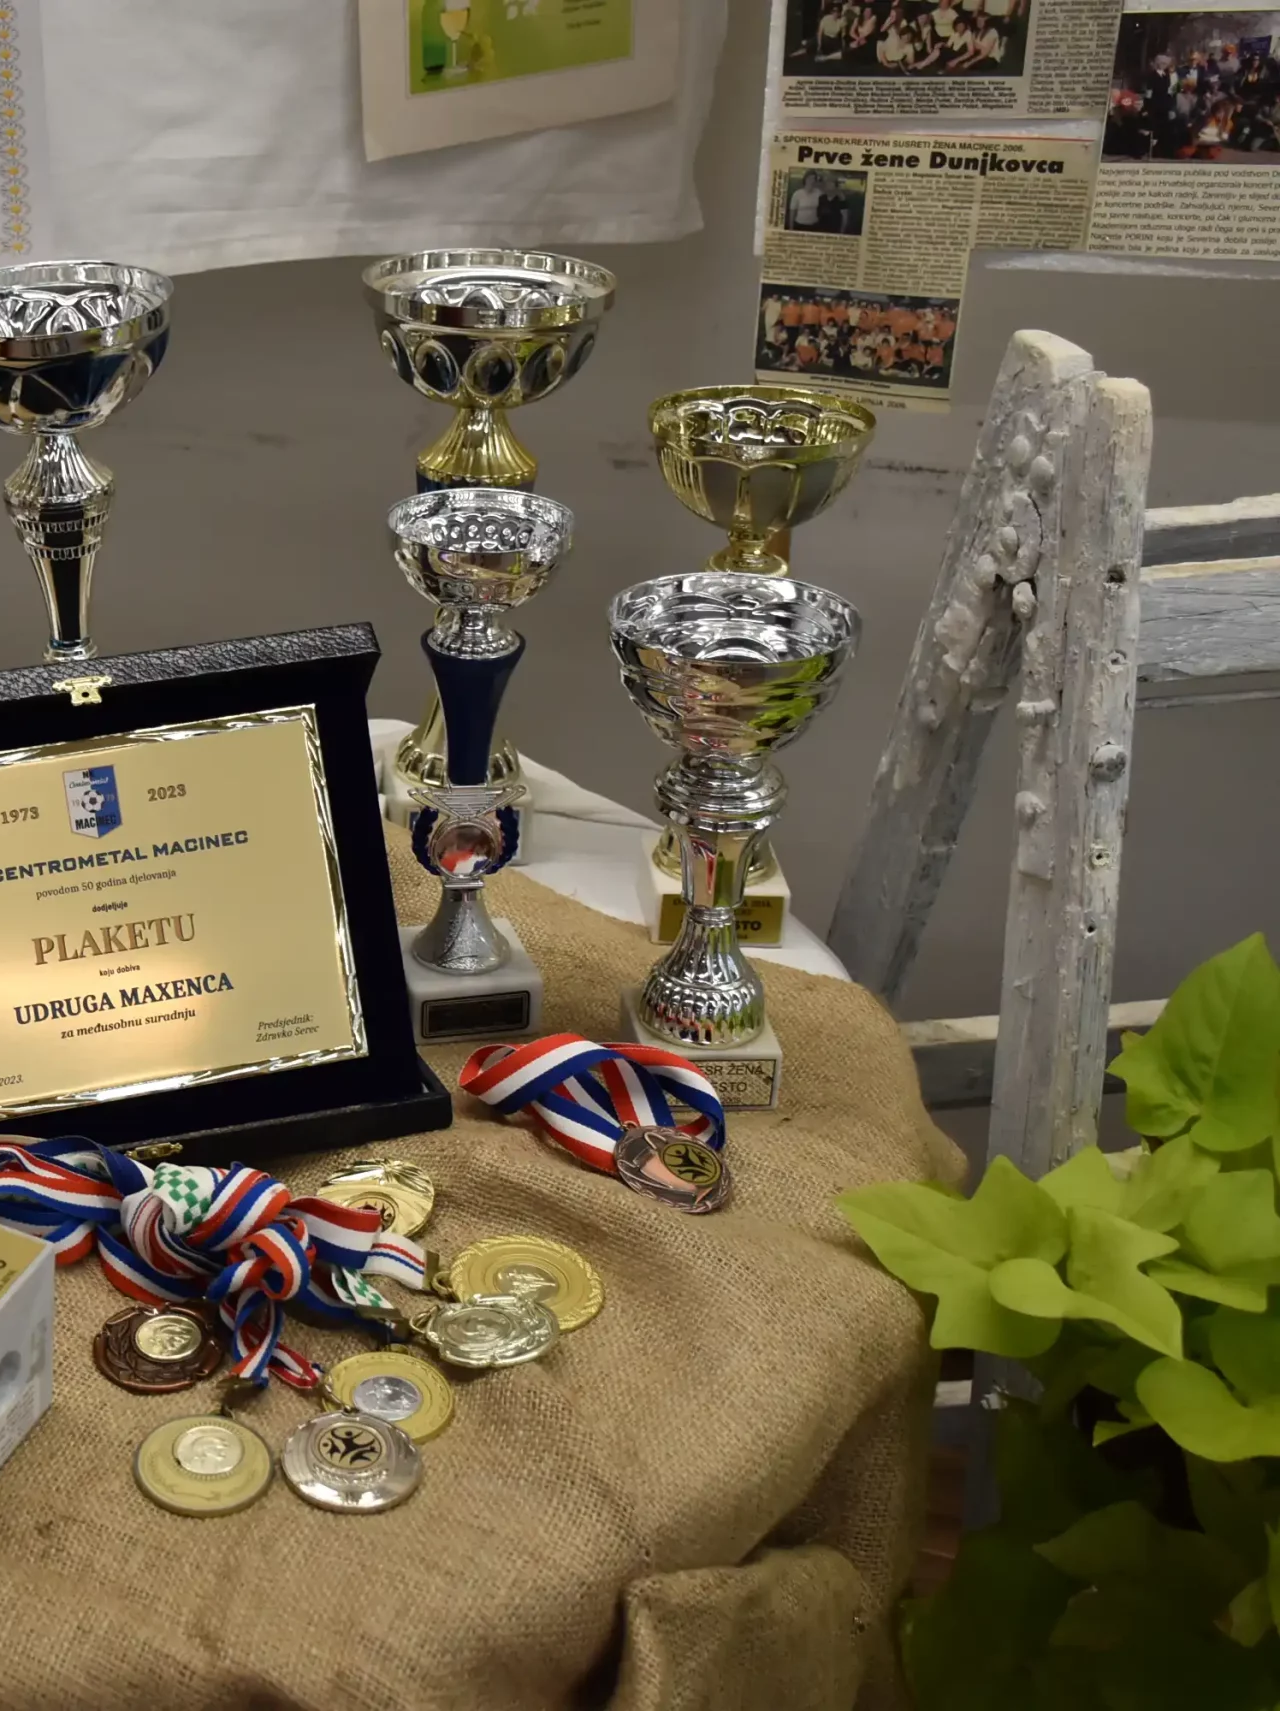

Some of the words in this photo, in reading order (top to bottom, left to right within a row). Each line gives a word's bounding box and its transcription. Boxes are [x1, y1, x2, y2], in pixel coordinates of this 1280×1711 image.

[932, 140, 957, 150] ŽENA
[959, 142, 1001, 152] MACINEC
[798, 145, 853, 166] Prve
[860, 148, 920, 168] žene
[930, 151, 1064, 176] Dunjkovca
[82, 770, 95, 779] NK
[147, 784, 187, 802] 2023
[0, 806, 40, 824] 1973
[75, 814, 117, 831] MACINEC
[152, 830, 249, 858] MACINEC
[36, 882, 80, 900] povodom
[82, 881, 94, 892] 50
[96, 876, 128, 892] godina
[129, 867, 177, 884] djelovanja
[92, 900, 128, 913] dodjeljuje
[32, 913, 196, 966] PLAKETU
[99, 968, 115, 977] koju
[116, 964, 141, 975] dobiva
[13, 992, 116, 1025] UDRUGA
[119, 972, 234, 1008] MAXENCA
[61, 1029, 74, 1039] za
[76, 1016, 143, 1038] međusobnu
[145, 1007, 196, 1026] suradnju
[257, 1013, 314, 1031] Predsjednik:
[256, 1029, 293, 1043] Zdravko
[294, 1025, 320, 1036] Serec
[727, 1062, 765, 1076] ŽENA
